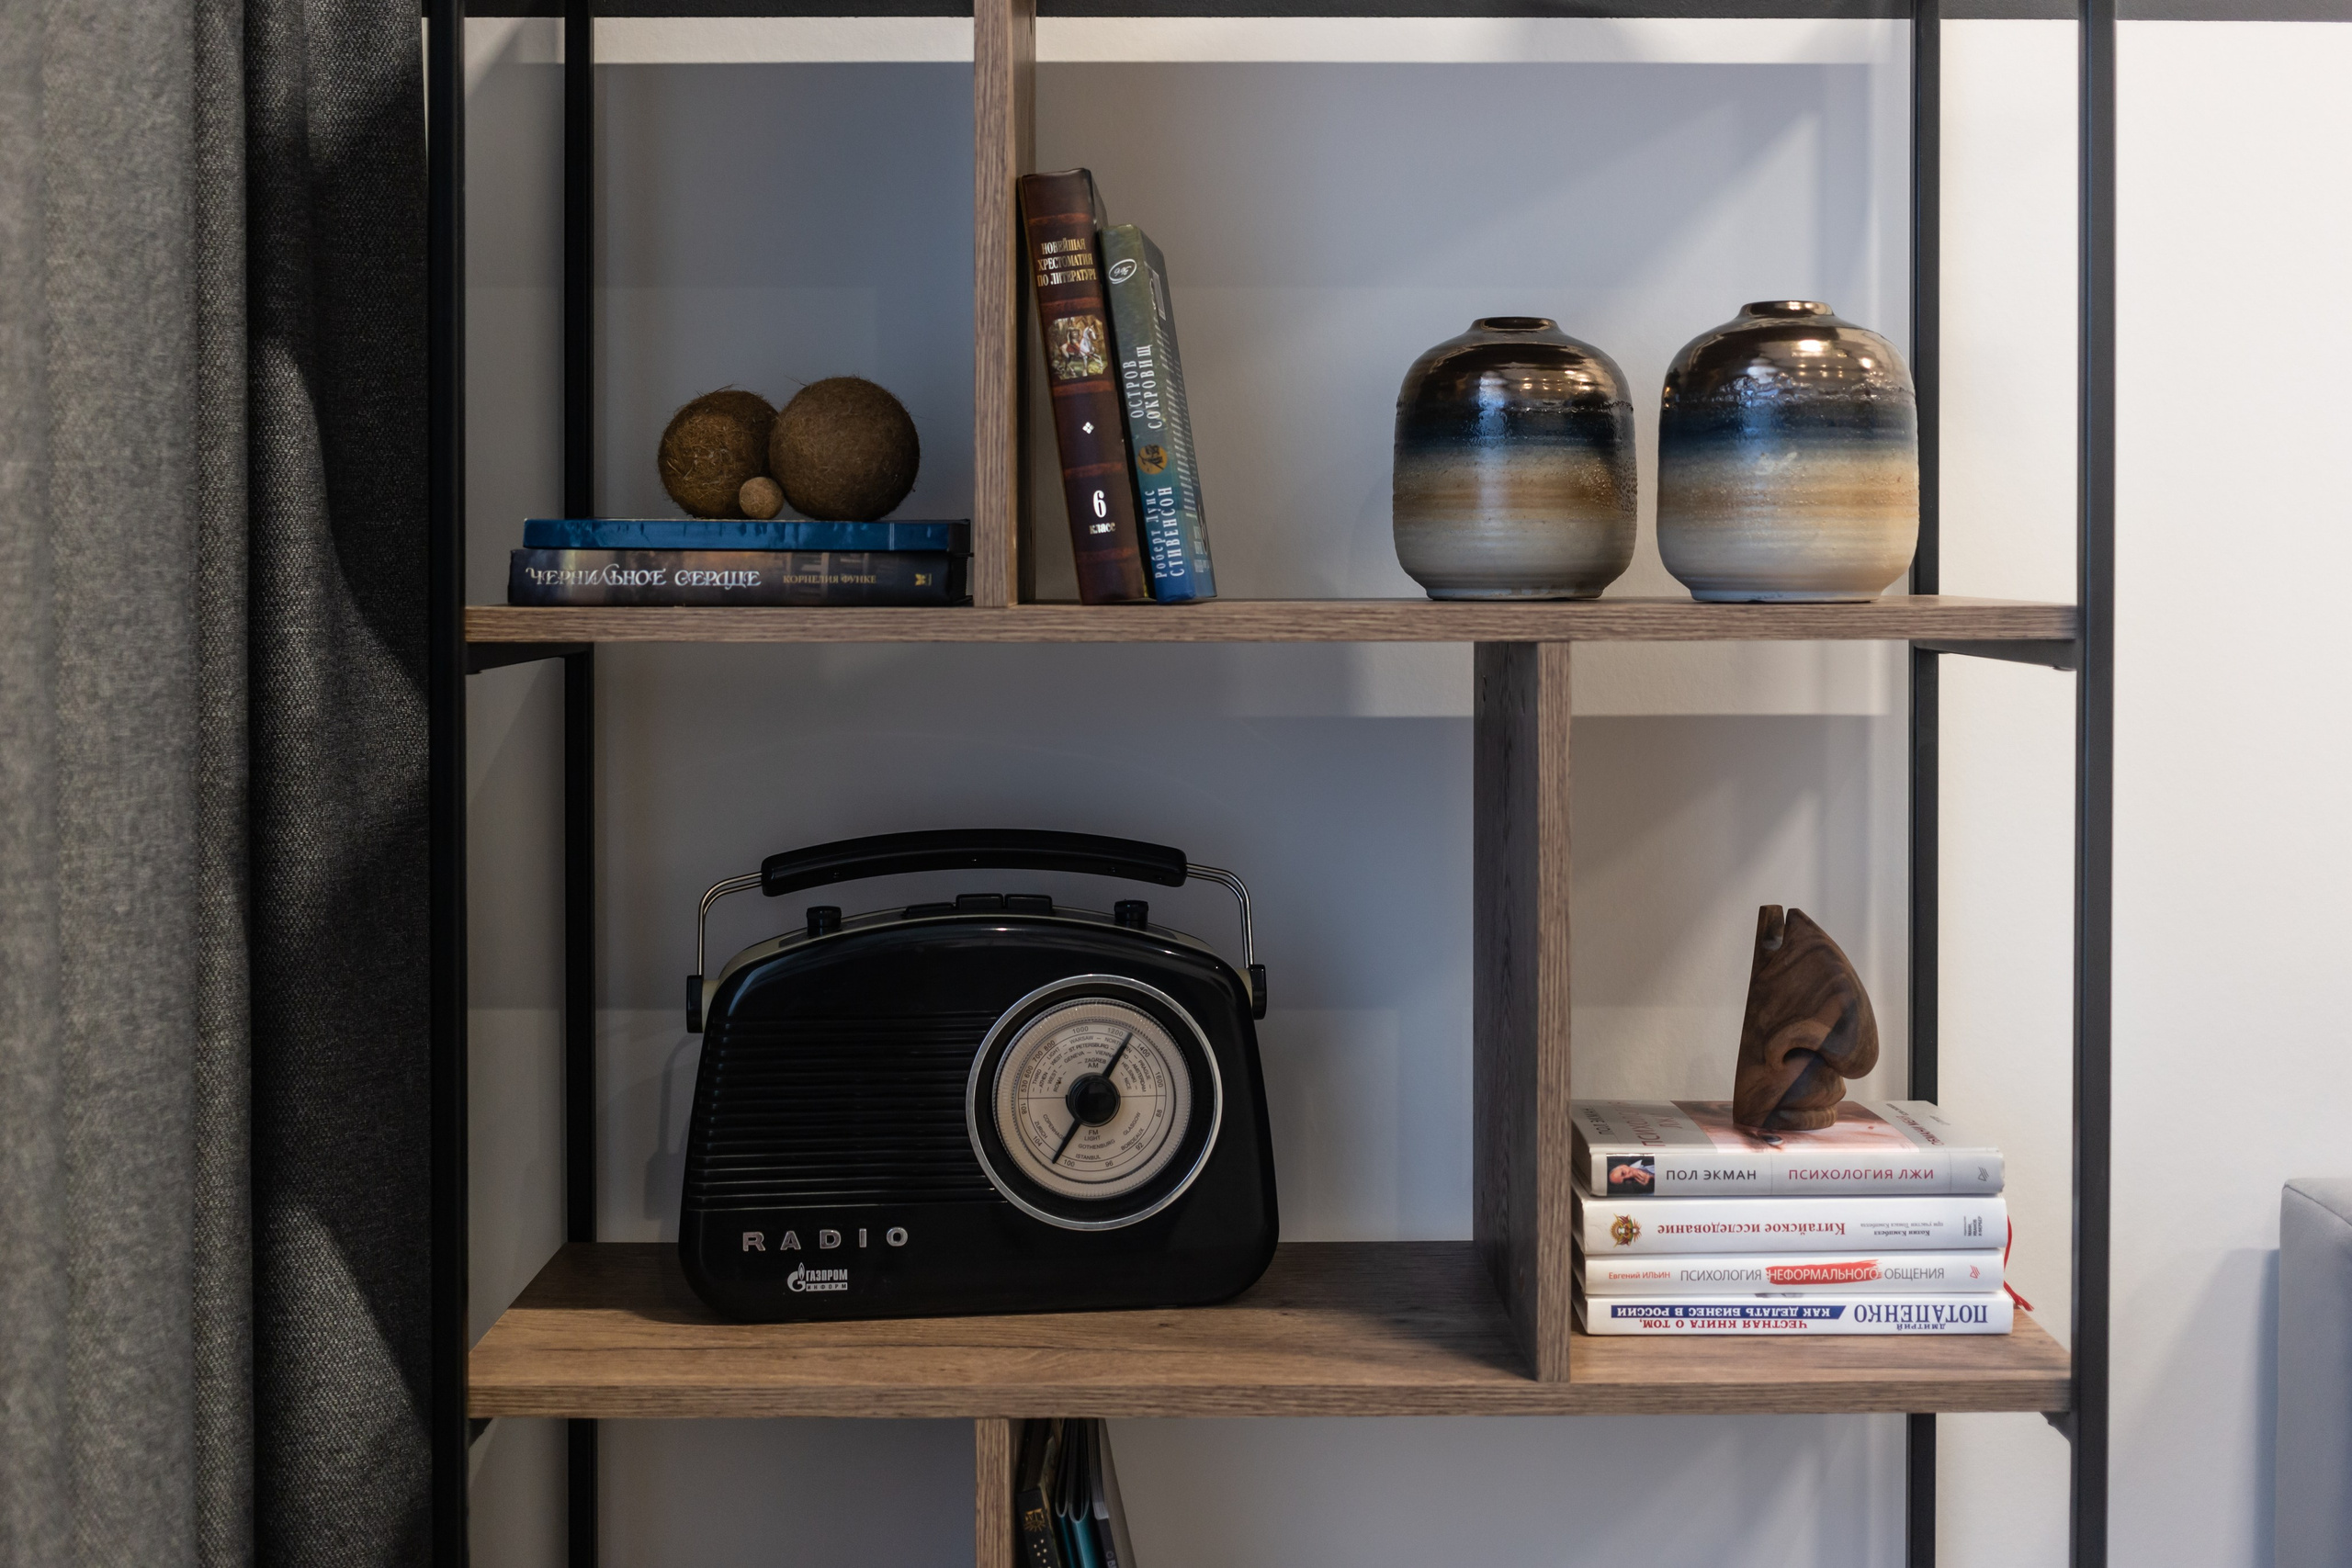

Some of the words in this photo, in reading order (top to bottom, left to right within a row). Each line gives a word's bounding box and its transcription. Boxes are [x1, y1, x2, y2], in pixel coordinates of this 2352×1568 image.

[1041, 238, 1086, 254] НОВЕЙШАЯ
[1037, 253, 1093, 271] ХРЕСТОМАТИЯ
[1036, 274, 1049, 288] ПО
[1123, 360, 1145, 419] ОСТРОВ
[1136, 344, 1163, 430] СОКРОВИЩ
[1092, 490, 1107, 518] 6
[1145, 490, 1161, 523] Луис
[1089, 522, 1116, 535] класс
[1158, 487, 1185, 577] СТИВЕНСОН
[1151, 530, 1168, 579] Роберт
[526, 563, 667, 586] ЧЕРНИЛЬНОЕ
[673, 570, 762, 590] СЕРДЦЕ
[783, 575, 839, 584] КОРНЕЛИЯ
[841, 575, 877, 584] ФУНКЕ
[1024, 1066, 1034, 1078] 600
[1033, 1050, 1044, 1063] 700
[1044, 1040, 1056, 1052] 800
[1072, 1025, 1089, 1034] 1000
[1107, 1027, 1124, 1037] 1200
[1136, 1043, 1150, 1058] 1400
[1155, 1071, 1164, 1088] 1600
[1032, 1068, 1042, 1085] THIRD
[1046, 1047, 1060, 1060] LIGHT
[1069, 1035, 1094, 1044] WARSAW
[1138, 1059, 1151, 1080] PRAGUE
[1047, 1069, 1057, 1085] WEST
[1064, 1051, 1085, 1064] GENEVA
[1121, 1061, 1136, 1084] HELSINKI
[1050, 1054, 1063, 1066] WEST
[1132, 1063, 1147, 1092] AMSTERDAM
[1124, 1077, 1133, 1090] NICE
[1034, 1121, 1048, 1139] ZURICH
[1120, 1128, 1145, 1151] BORDEAUX
[1078, 1139, 1115, 1150] GOTHENBURG
[1123, 1111, 1141, 1136] GLASGOW
[1033, 1135, 1043, 1147] 104
[1064, 1159, 1075, 1168] 100
[1135, 1142, 1144, 1151] 92
[1156, 1109, 1162, 1118] 88
[1666, 1169, 1698, 1180] ПОЛ
[1702, 1169, 1757, 1180] ЭКМАН
[1788, 1168, 1894, 1180] ПСИХОЛОГИЯ
[1898, 1168, 1935, 1179] ЛЖИ
[1657, 1223, 1760, 1235] исследование
[1764, 1222, 1846, 1235] Китайское
[742, 1226, 909, 1252] RADIO
[806, 1269, 848, 1281] ГАЗПРОМ
[1609, 1271, 1641, 1280] Евгений
[1680, 1269, 1762, 1281] ПСИХОЛОГИЯ
[1769, 1267, 1878, 1281] НЕФОРМАЛЬНОГО
[1883, 1268, 1945, 1281] ОБЩЕНИЯ
[1617, 1307, 1670, 1316] РОССИИ
[1674, 1307, 1683, 1316] В
[1689, 1307, 1741, 1316] БИЗНЕС
[1746, 1306, 1799, 1316] ДЕЛАТЬ
[1803, 1307, 1831, 1316] КАК
[1854, 1304, 1988, 1323] ПОТАПЕНКО
[1639, 1318, 1671, 1328] ТОМ,
[1675, 1319, 1685, 1328] О
[1690, 1320, 1737, 1328] КНИГА
[1742, 1320, 1808, 1328] ЧЕСТНАЯ
[1896, 1323, 1947, 1331] ДМИТРИЙ
